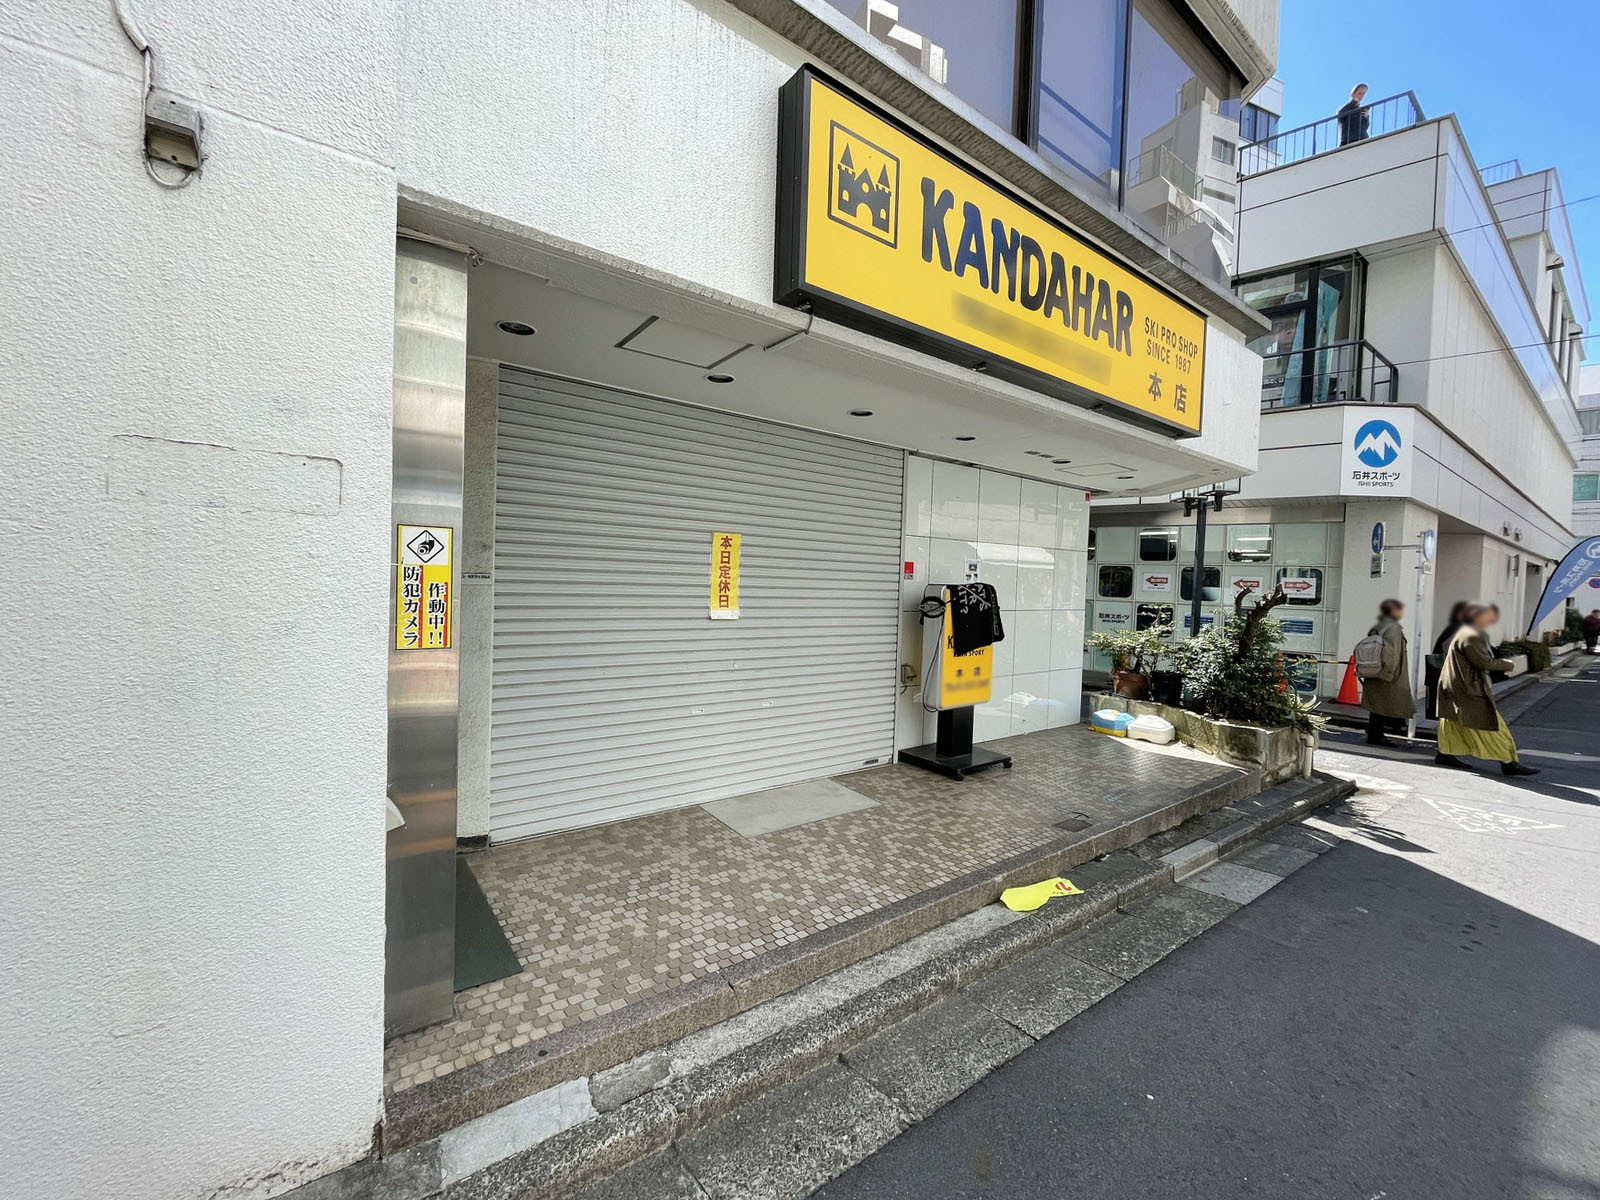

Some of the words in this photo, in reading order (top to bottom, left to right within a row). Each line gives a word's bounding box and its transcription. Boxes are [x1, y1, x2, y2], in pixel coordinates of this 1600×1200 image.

[921, 176, 1134, 357] KANDAHAR
[1144, 316, 1159, 339] SKI
[1160, 326, 1177, 348] PRO
[1178, 335, 1198, 359] SHOP
[1146, 338, 1171, 365] SINCE
[1175, 353, 1191, 375] 1987
[1352, 470, 1401, 481] 石井スポーツ
[718, 535, 733, 609] 本日定休日
[403, 566, 420, 647] 防犯カメラ
